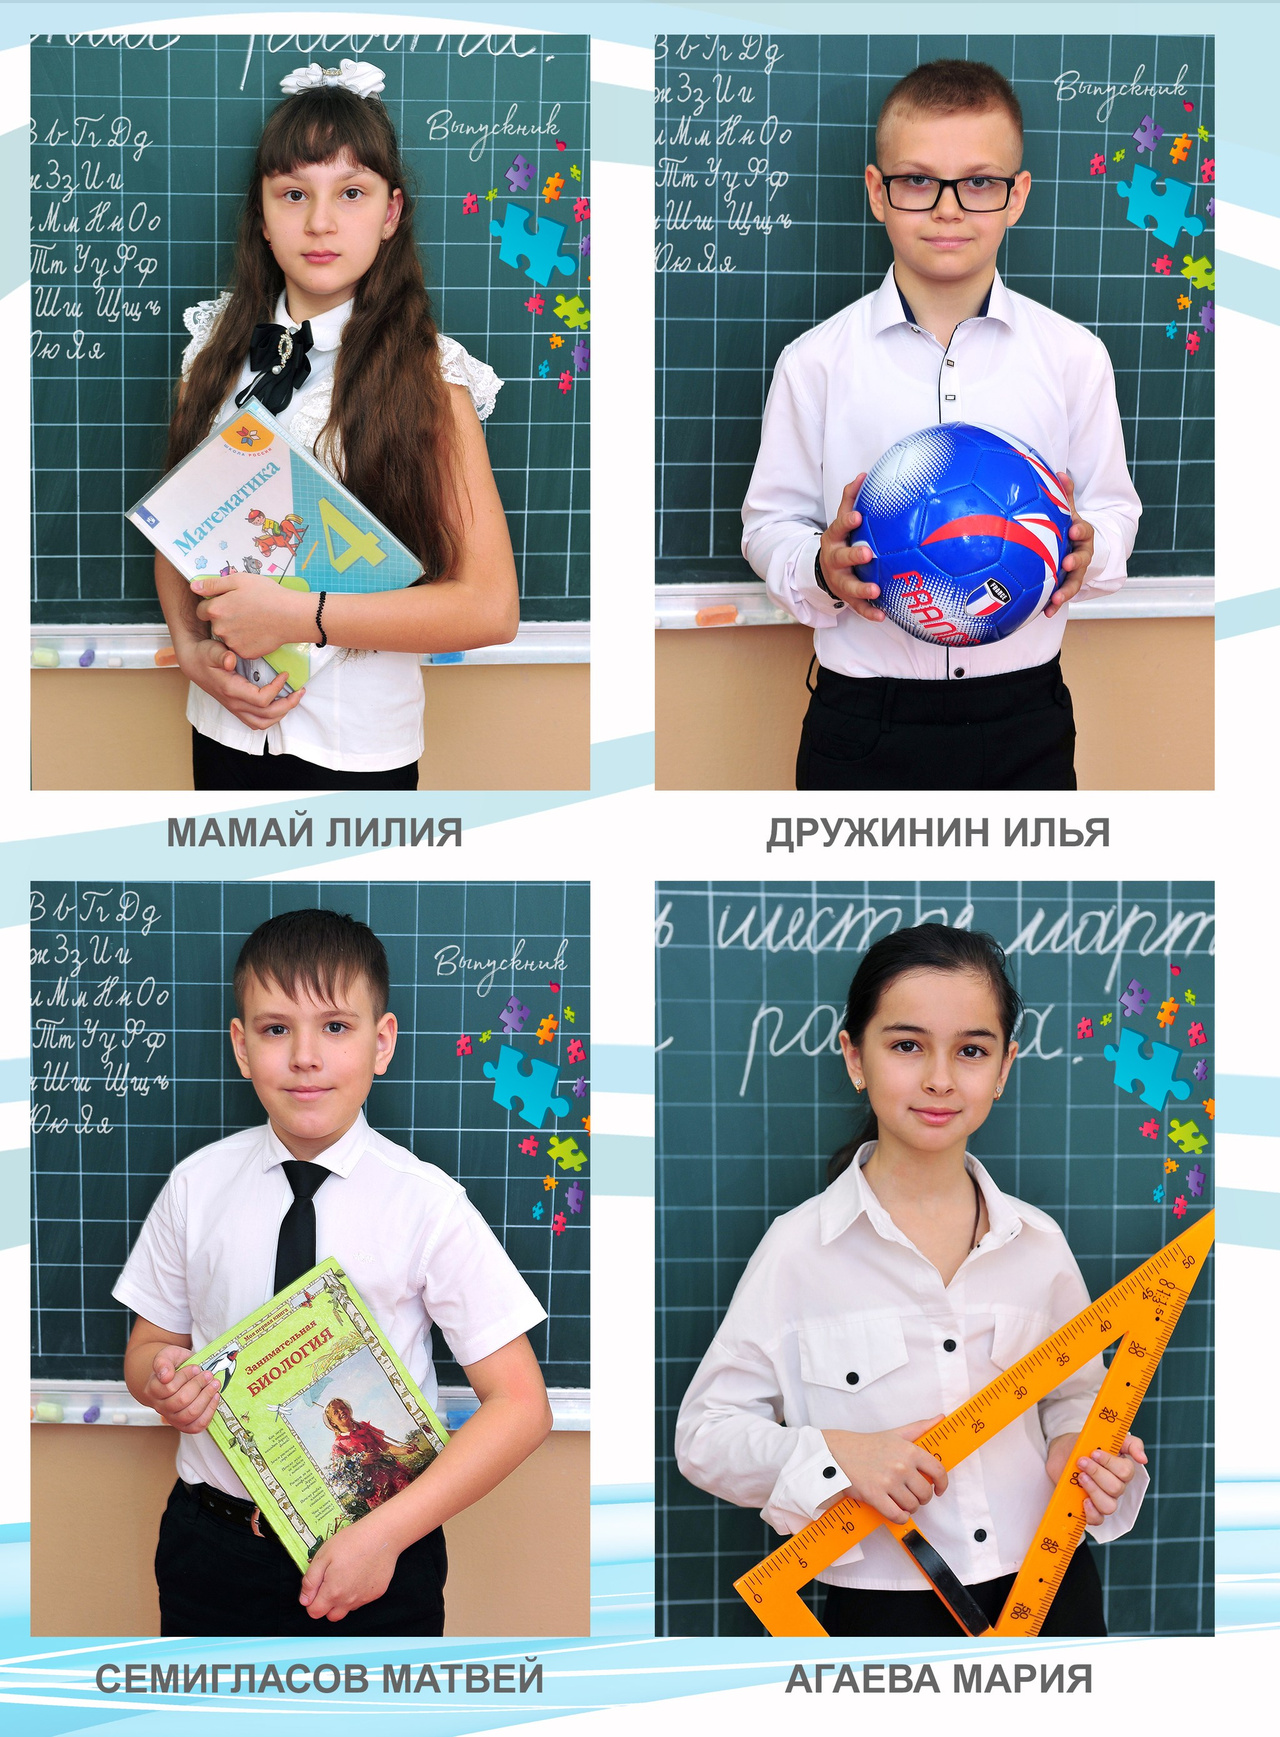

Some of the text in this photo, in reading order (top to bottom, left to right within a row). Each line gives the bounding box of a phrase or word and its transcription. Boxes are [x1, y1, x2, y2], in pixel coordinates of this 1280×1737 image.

[1054, 63, 1189, 122] Выпускник
[426, 102, 560, 162] Выпускник
[223, 443, 272, 457] ШКОЛА РОССИИ
[172, 461, 281, 557] Математика
[318, 496, 389, 574] 4
[990, 583, 1008, 601] FRANCE
[435, 939, 569, 997] Выпускник
[1182, 1255, 1196, 1269] 50
[1142, 1287, 1154, 1300] 45
[243, 1308, 289, 1342] Моя первая книга
[1099, 1320, 1113, 1334] 40
[245, 1320, 317, 1375] Занимательная
[1128, 1340, 1141, 1355] 20
[1135, 1346, 1147, 1358] 10
[246, 1327, 334, 1397] БИОЛОГИЯ
[1056, 1353, 1070, 1367] 35
[1013, 1386, 1028, 1400] 30
[1098, 1406, 1112, 1420] 40
[1105, 1409, 1119, 1423] 20
[971, 1420, 986, 1434] 25
[841, 1521, 855, 1535] 10
[1040, 1537, 1052, 1551] 80
[1047, 1540, 1059, 1554] 40
[798, 1559, 808, 1569] 5
[753, 1594, 763, 1604] 0
[1010, 1602, 1024, 1620] 100
[1019, 1607, 1032, 1620] 50
